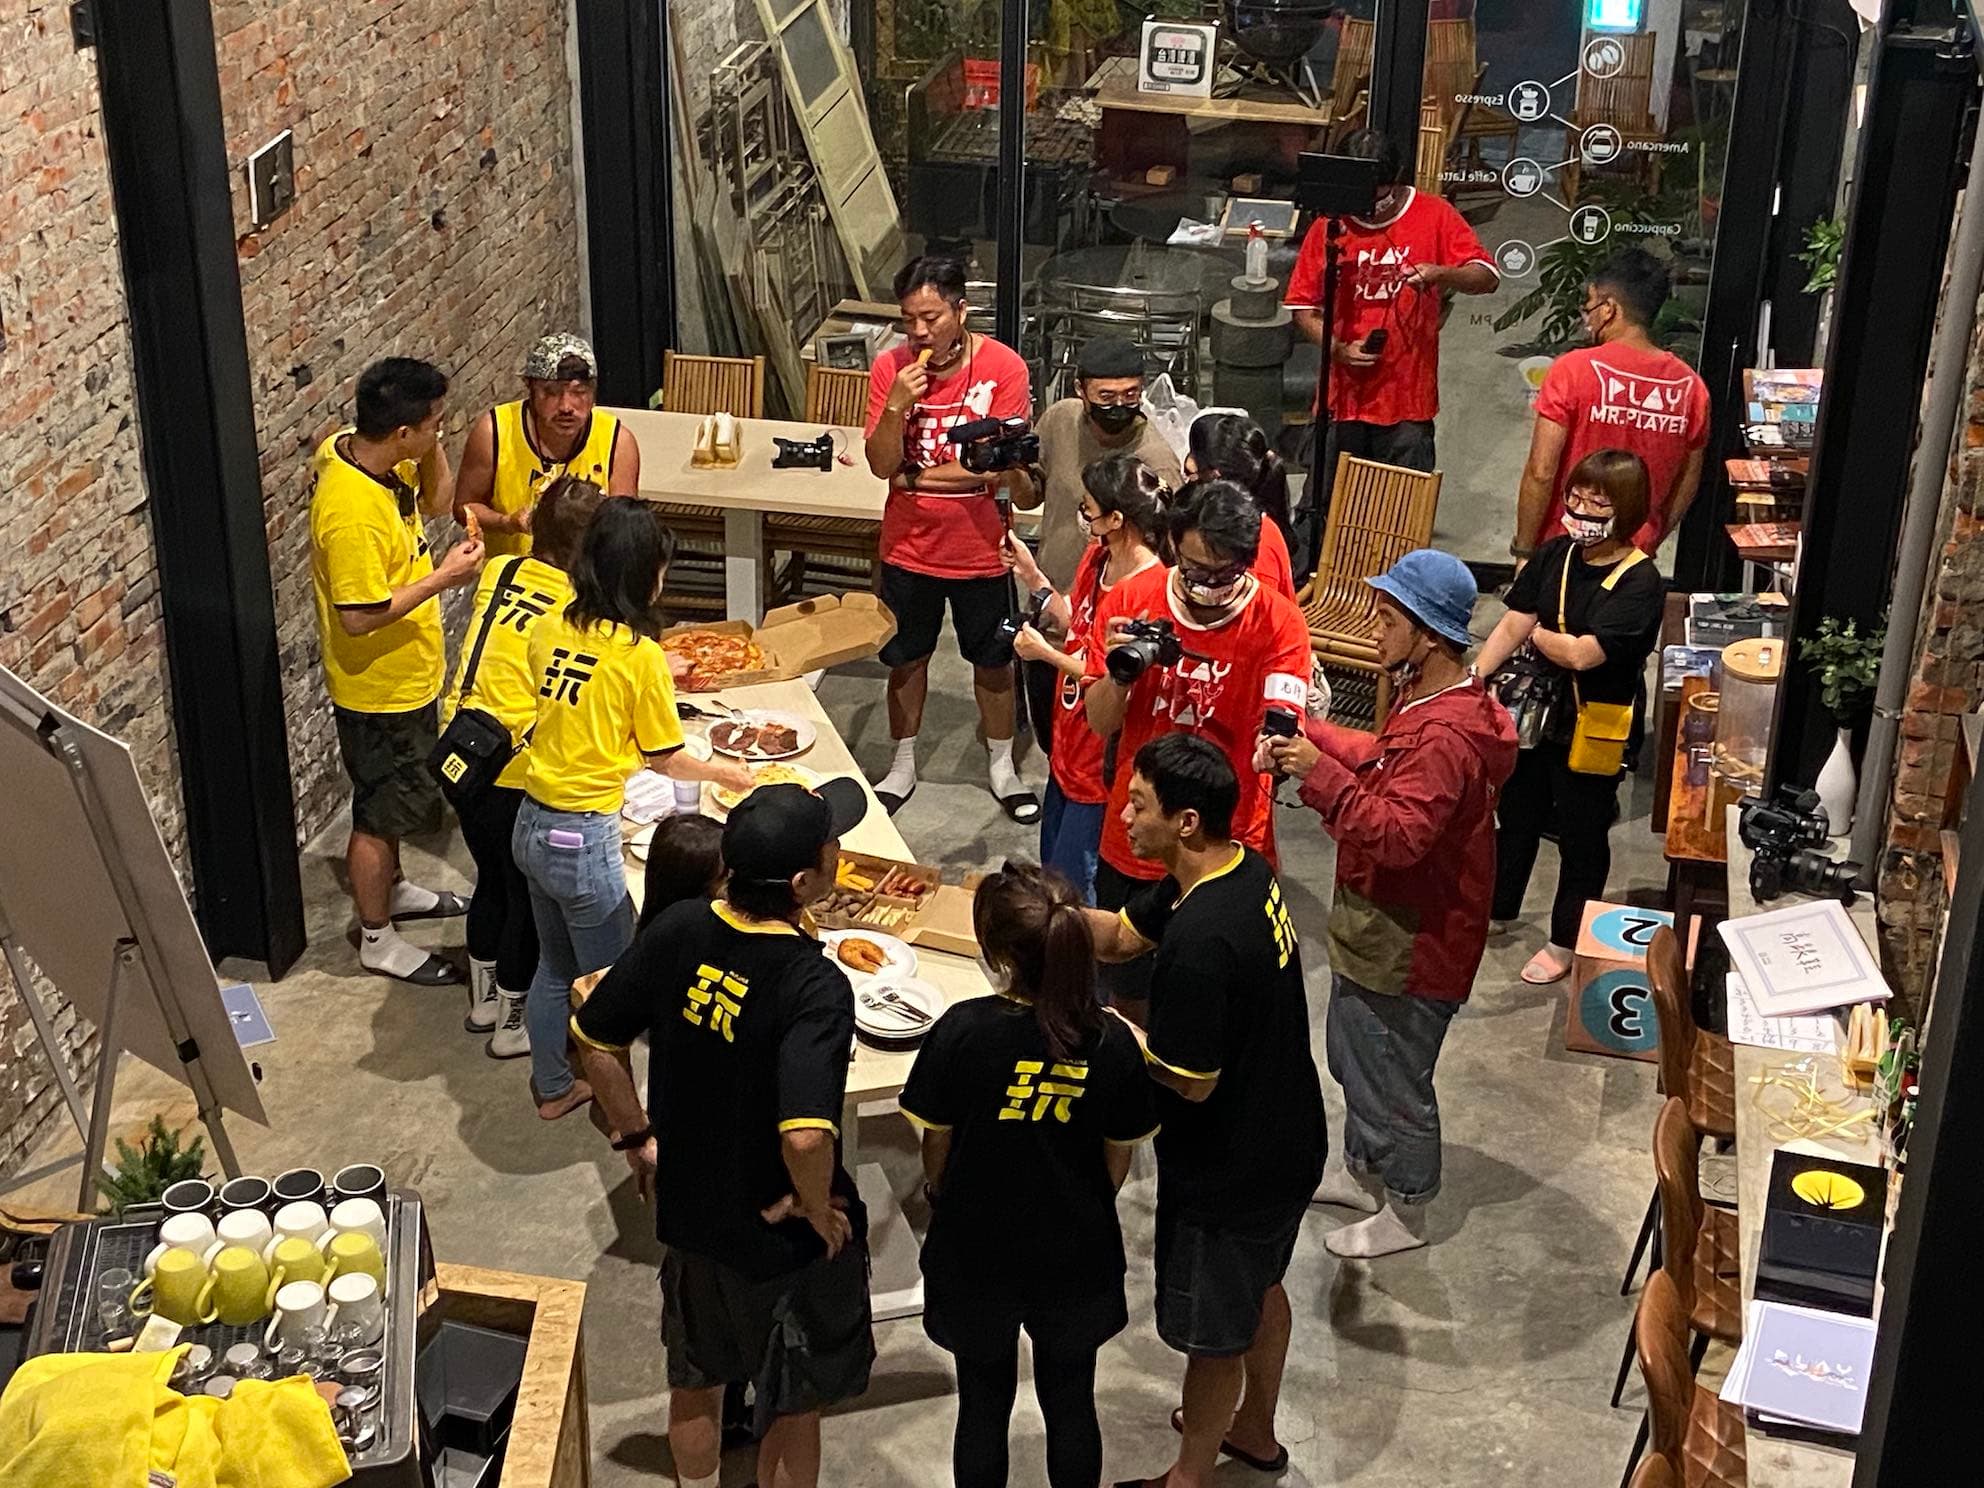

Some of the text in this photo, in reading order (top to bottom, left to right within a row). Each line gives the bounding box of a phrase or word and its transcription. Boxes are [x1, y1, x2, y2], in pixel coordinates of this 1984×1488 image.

[1358, 246, 1410, 267] PLAY
[1354, 281, 1402, 300] PLAY
[1608, 377, 1682, 412] PLAY
[540, 648, 598, 706] 玩
[1163, 656, 1232, 684] LAY
[1621, 916, 1660, 947] 2
[683, 964, 749, 1042] 玩
[1609, 976, 1650, 1038] 3
[999, 1061, 1089, 1123] 玩
